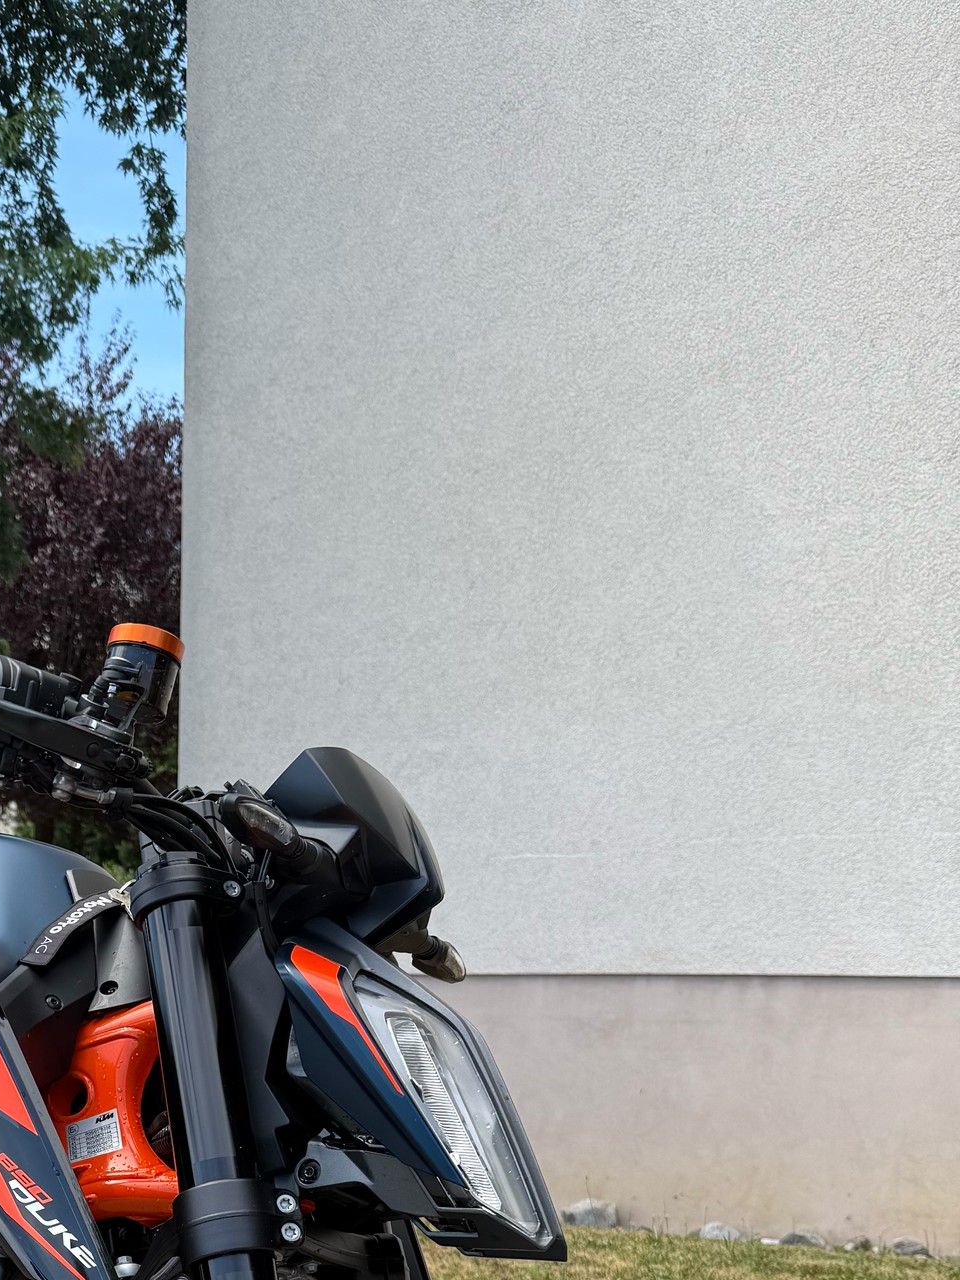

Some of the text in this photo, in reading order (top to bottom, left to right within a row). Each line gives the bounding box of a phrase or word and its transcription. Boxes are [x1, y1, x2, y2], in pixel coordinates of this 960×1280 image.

[35, 896, 113, 954] MotoPro AC
[95, 1112, 114, 1124] KTM
[8, 1179, 97, 1269] DUKE
